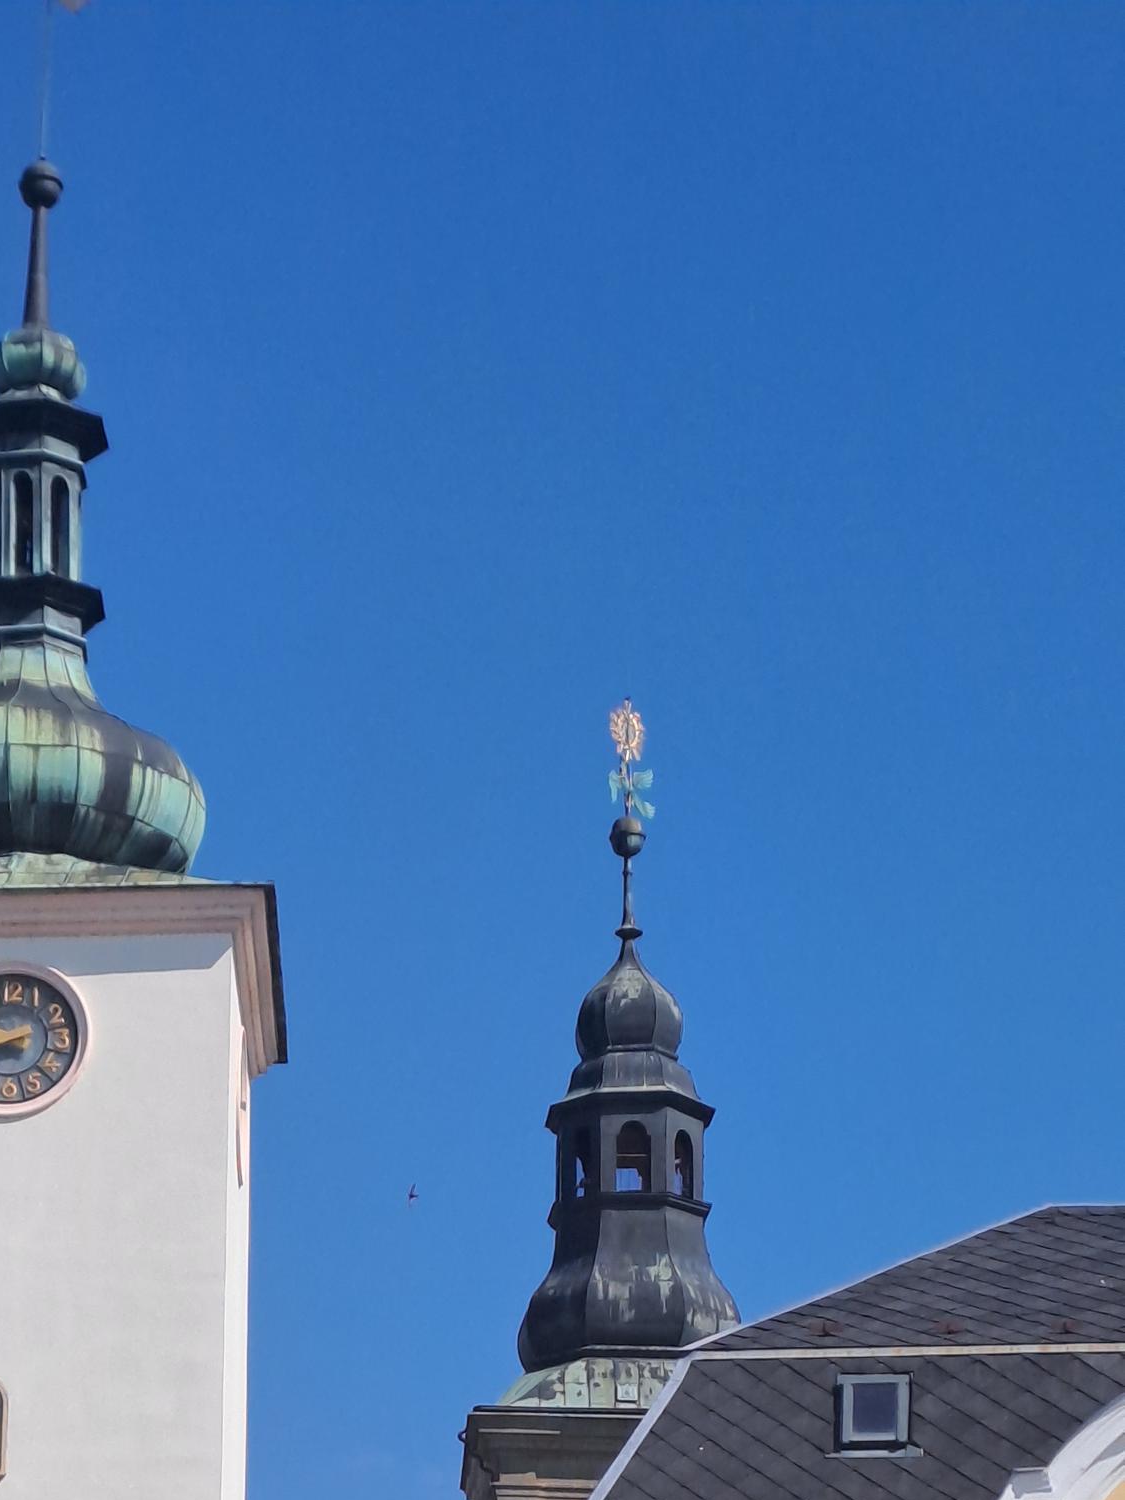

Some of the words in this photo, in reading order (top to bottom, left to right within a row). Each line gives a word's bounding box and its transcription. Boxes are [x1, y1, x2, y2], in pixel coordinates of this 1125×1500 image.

[3, 981, 23, 1002] 12
[32, 986, 40, 1007] 1
[48, 1003, 65, 1024] 2
[53, 1028, 70, 1052] 3
[44, 1052, 61, 1072] 4
[1, 1078, 18, 1098] 6
[26, 1072, 42, 1093] 5
